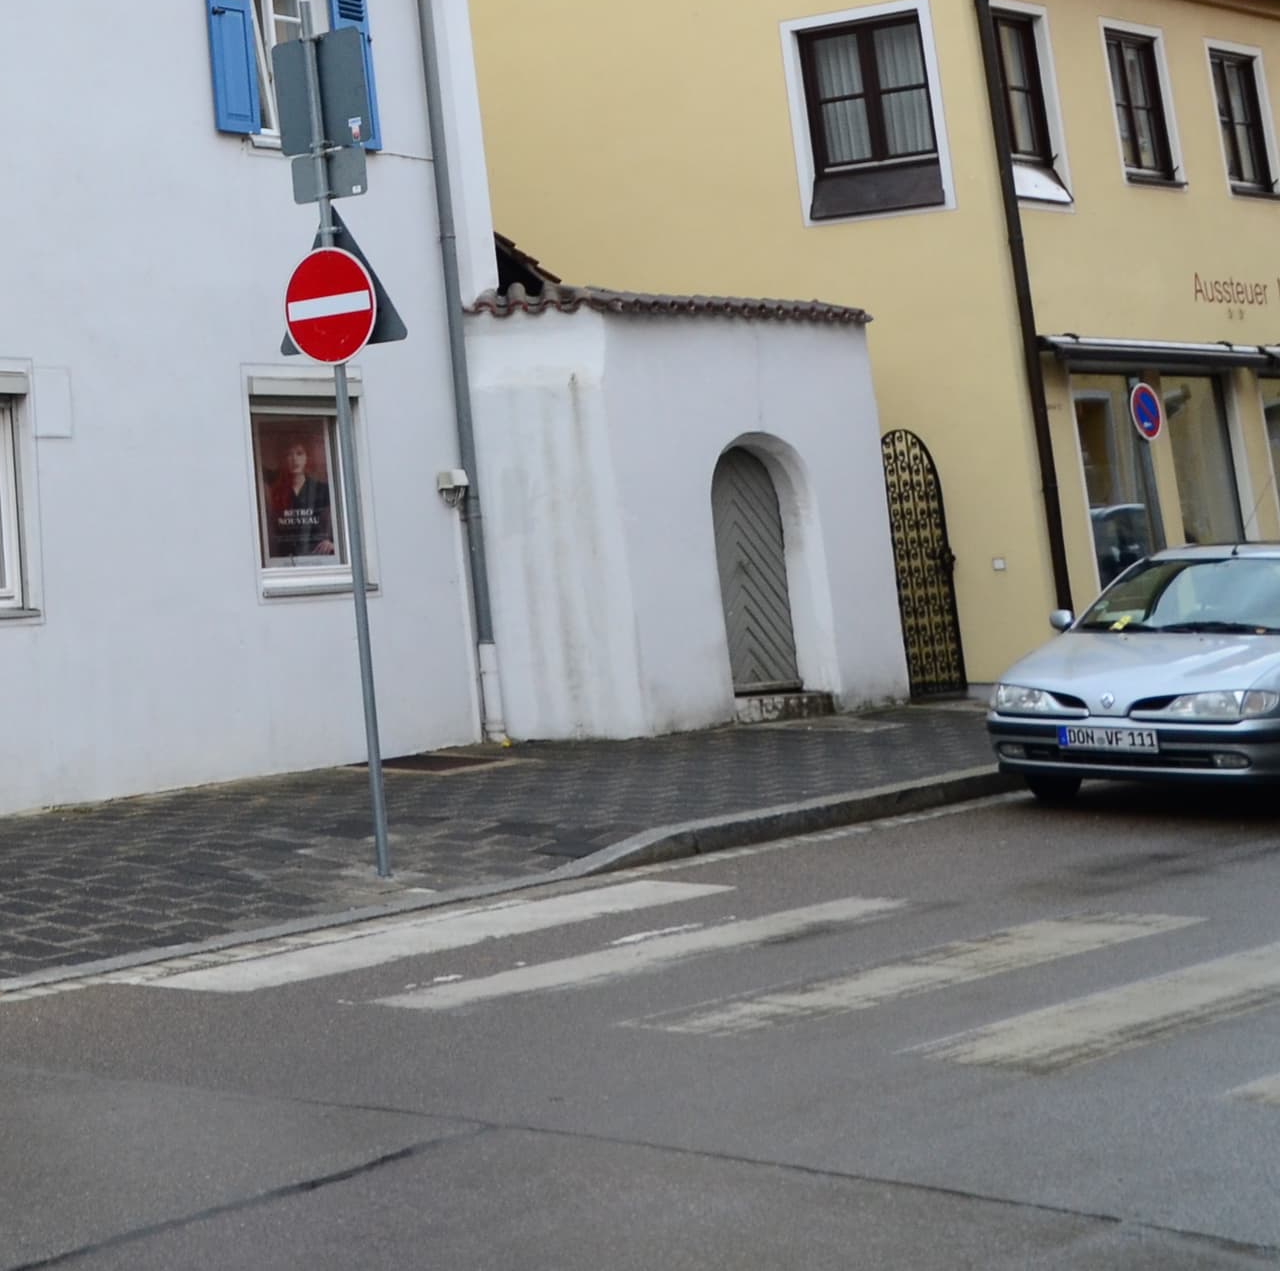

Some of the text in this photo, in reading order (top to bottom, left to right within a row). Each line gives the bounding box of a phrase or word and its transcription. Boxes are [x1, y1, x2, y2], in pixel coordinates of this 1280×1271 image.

[1194, 271, 1268, 306] Aussteuer
[283, 508, 313, 517] RETRO
[1068, 729, 1155, 747] DON VF 111
